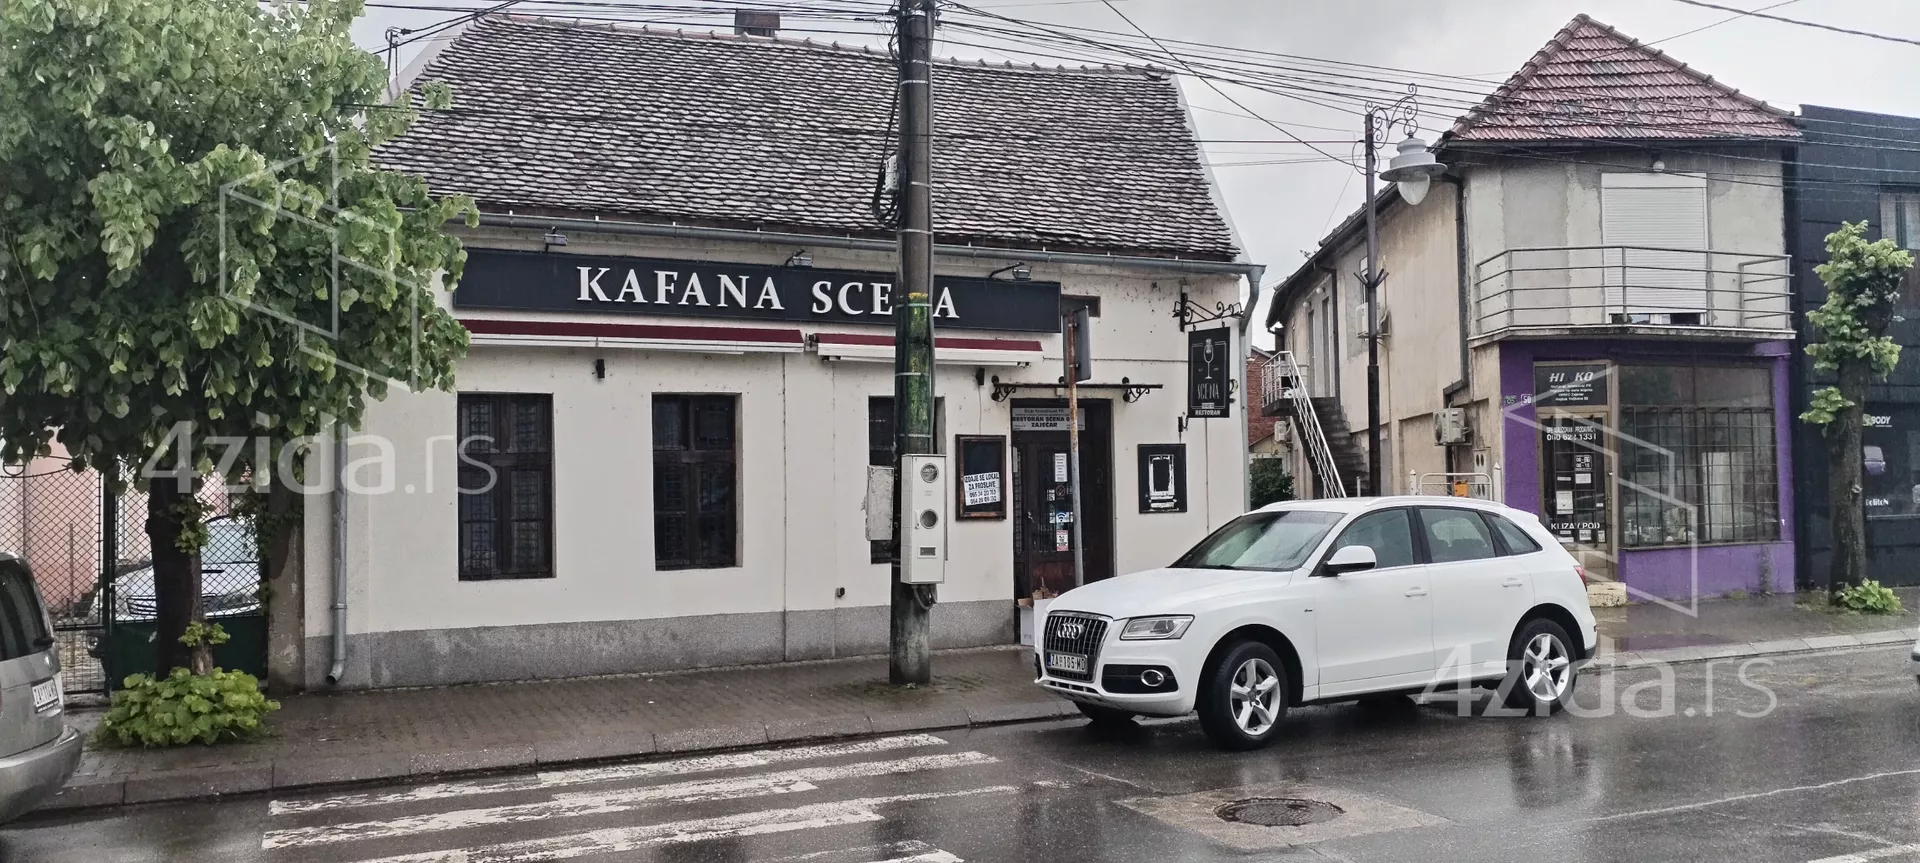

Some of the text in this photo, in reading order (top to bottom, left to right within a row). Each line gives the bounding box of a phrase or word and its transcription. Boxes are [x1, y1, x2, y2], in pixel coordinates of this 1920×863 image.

[577, 266, 960, 319] KAFANA SCEA
[1197, 383, 1219, 400] SCENA
[986, 472, 999, 480] LOKAL
